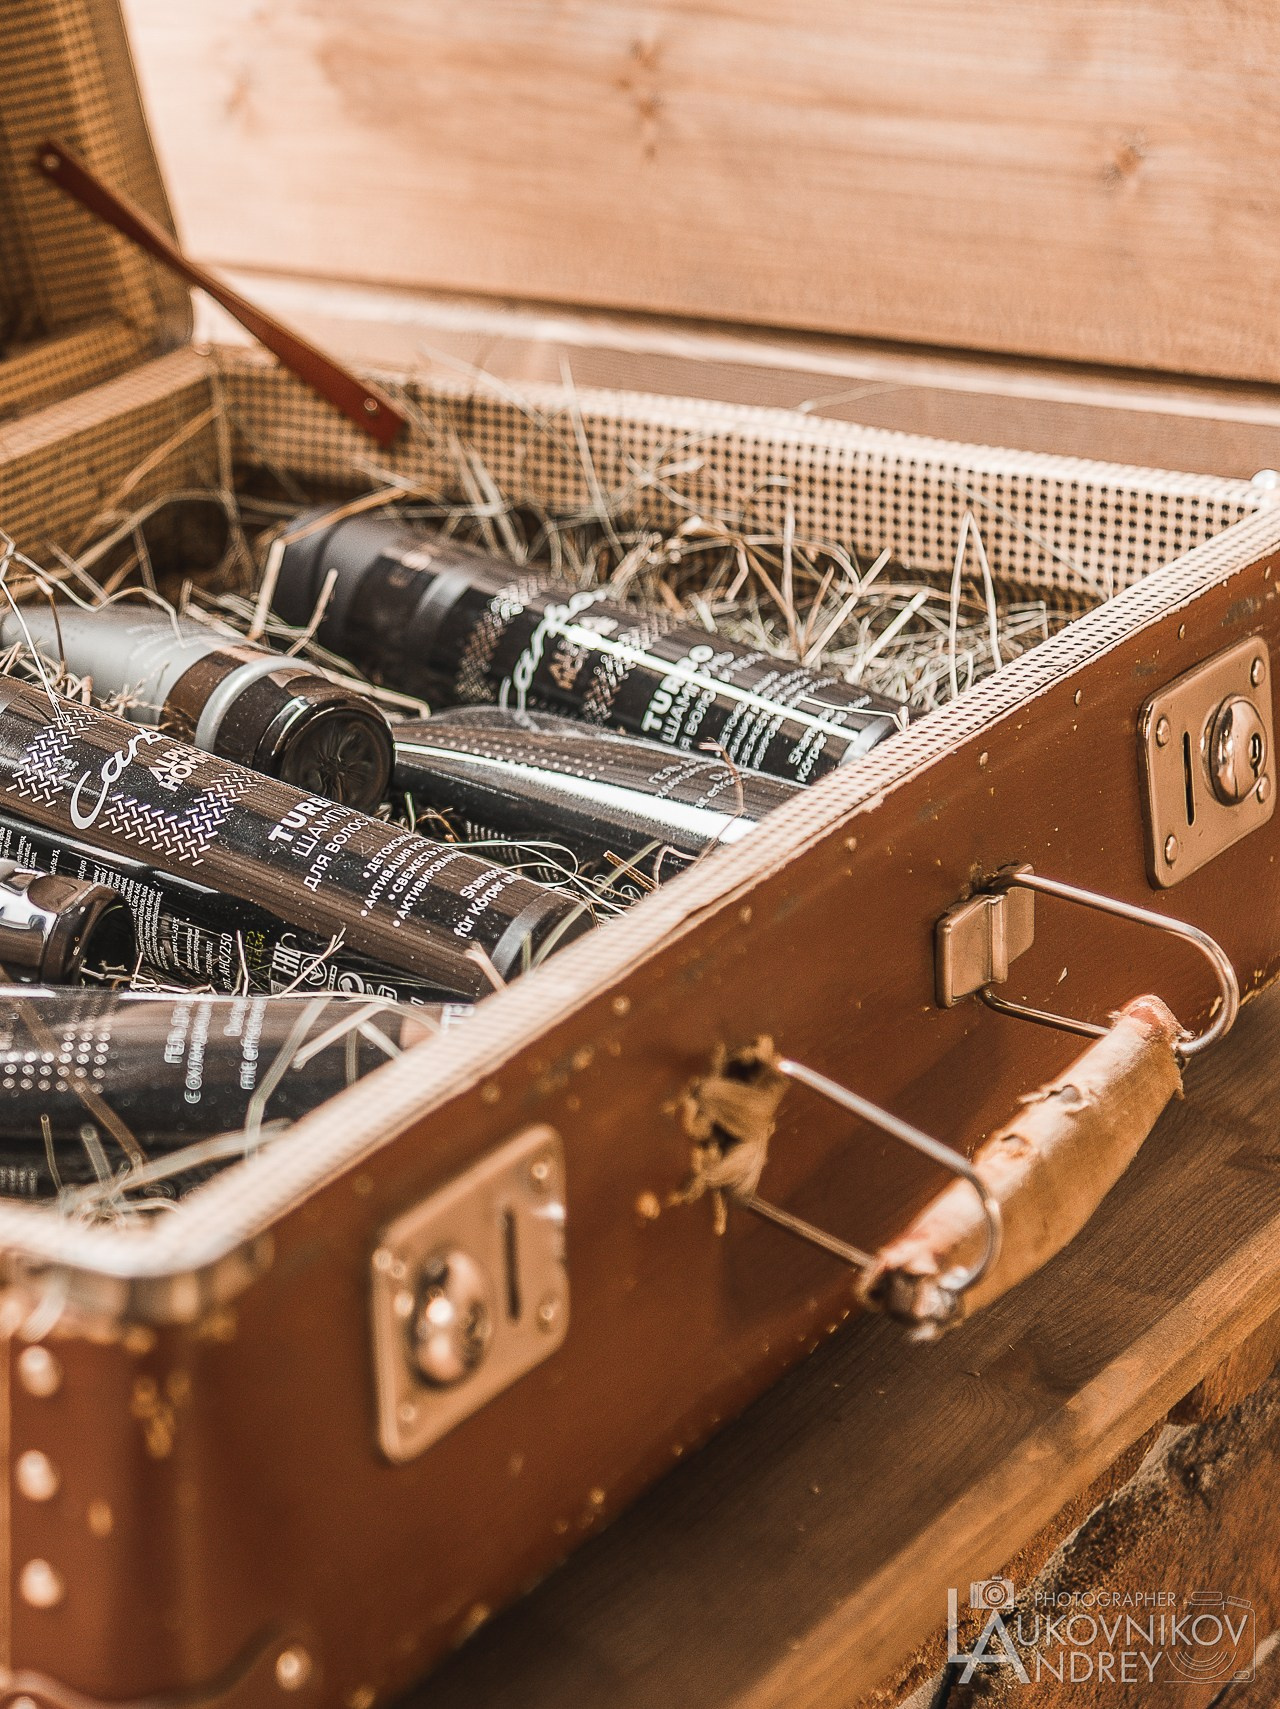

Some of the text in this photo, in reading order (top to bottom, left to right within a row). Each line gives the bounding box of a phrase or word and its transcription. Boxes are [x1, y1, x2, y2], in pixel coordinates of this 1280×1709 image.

[148, 745, 195, 782] ALPH
[268, 797, 332, 842] TURB
[291, 807, 352, 857] ШАМПУ
[303, 818, 369, 892] ДЛЯ ВОЛОС
[364, 848, 415, 909] АКТИВАЦИЯ
[392, 849, 438, 892] СВЕЖЕСТЬ
[453, 915, 475, 938] für
[467, 881, 506, 916] Körper
